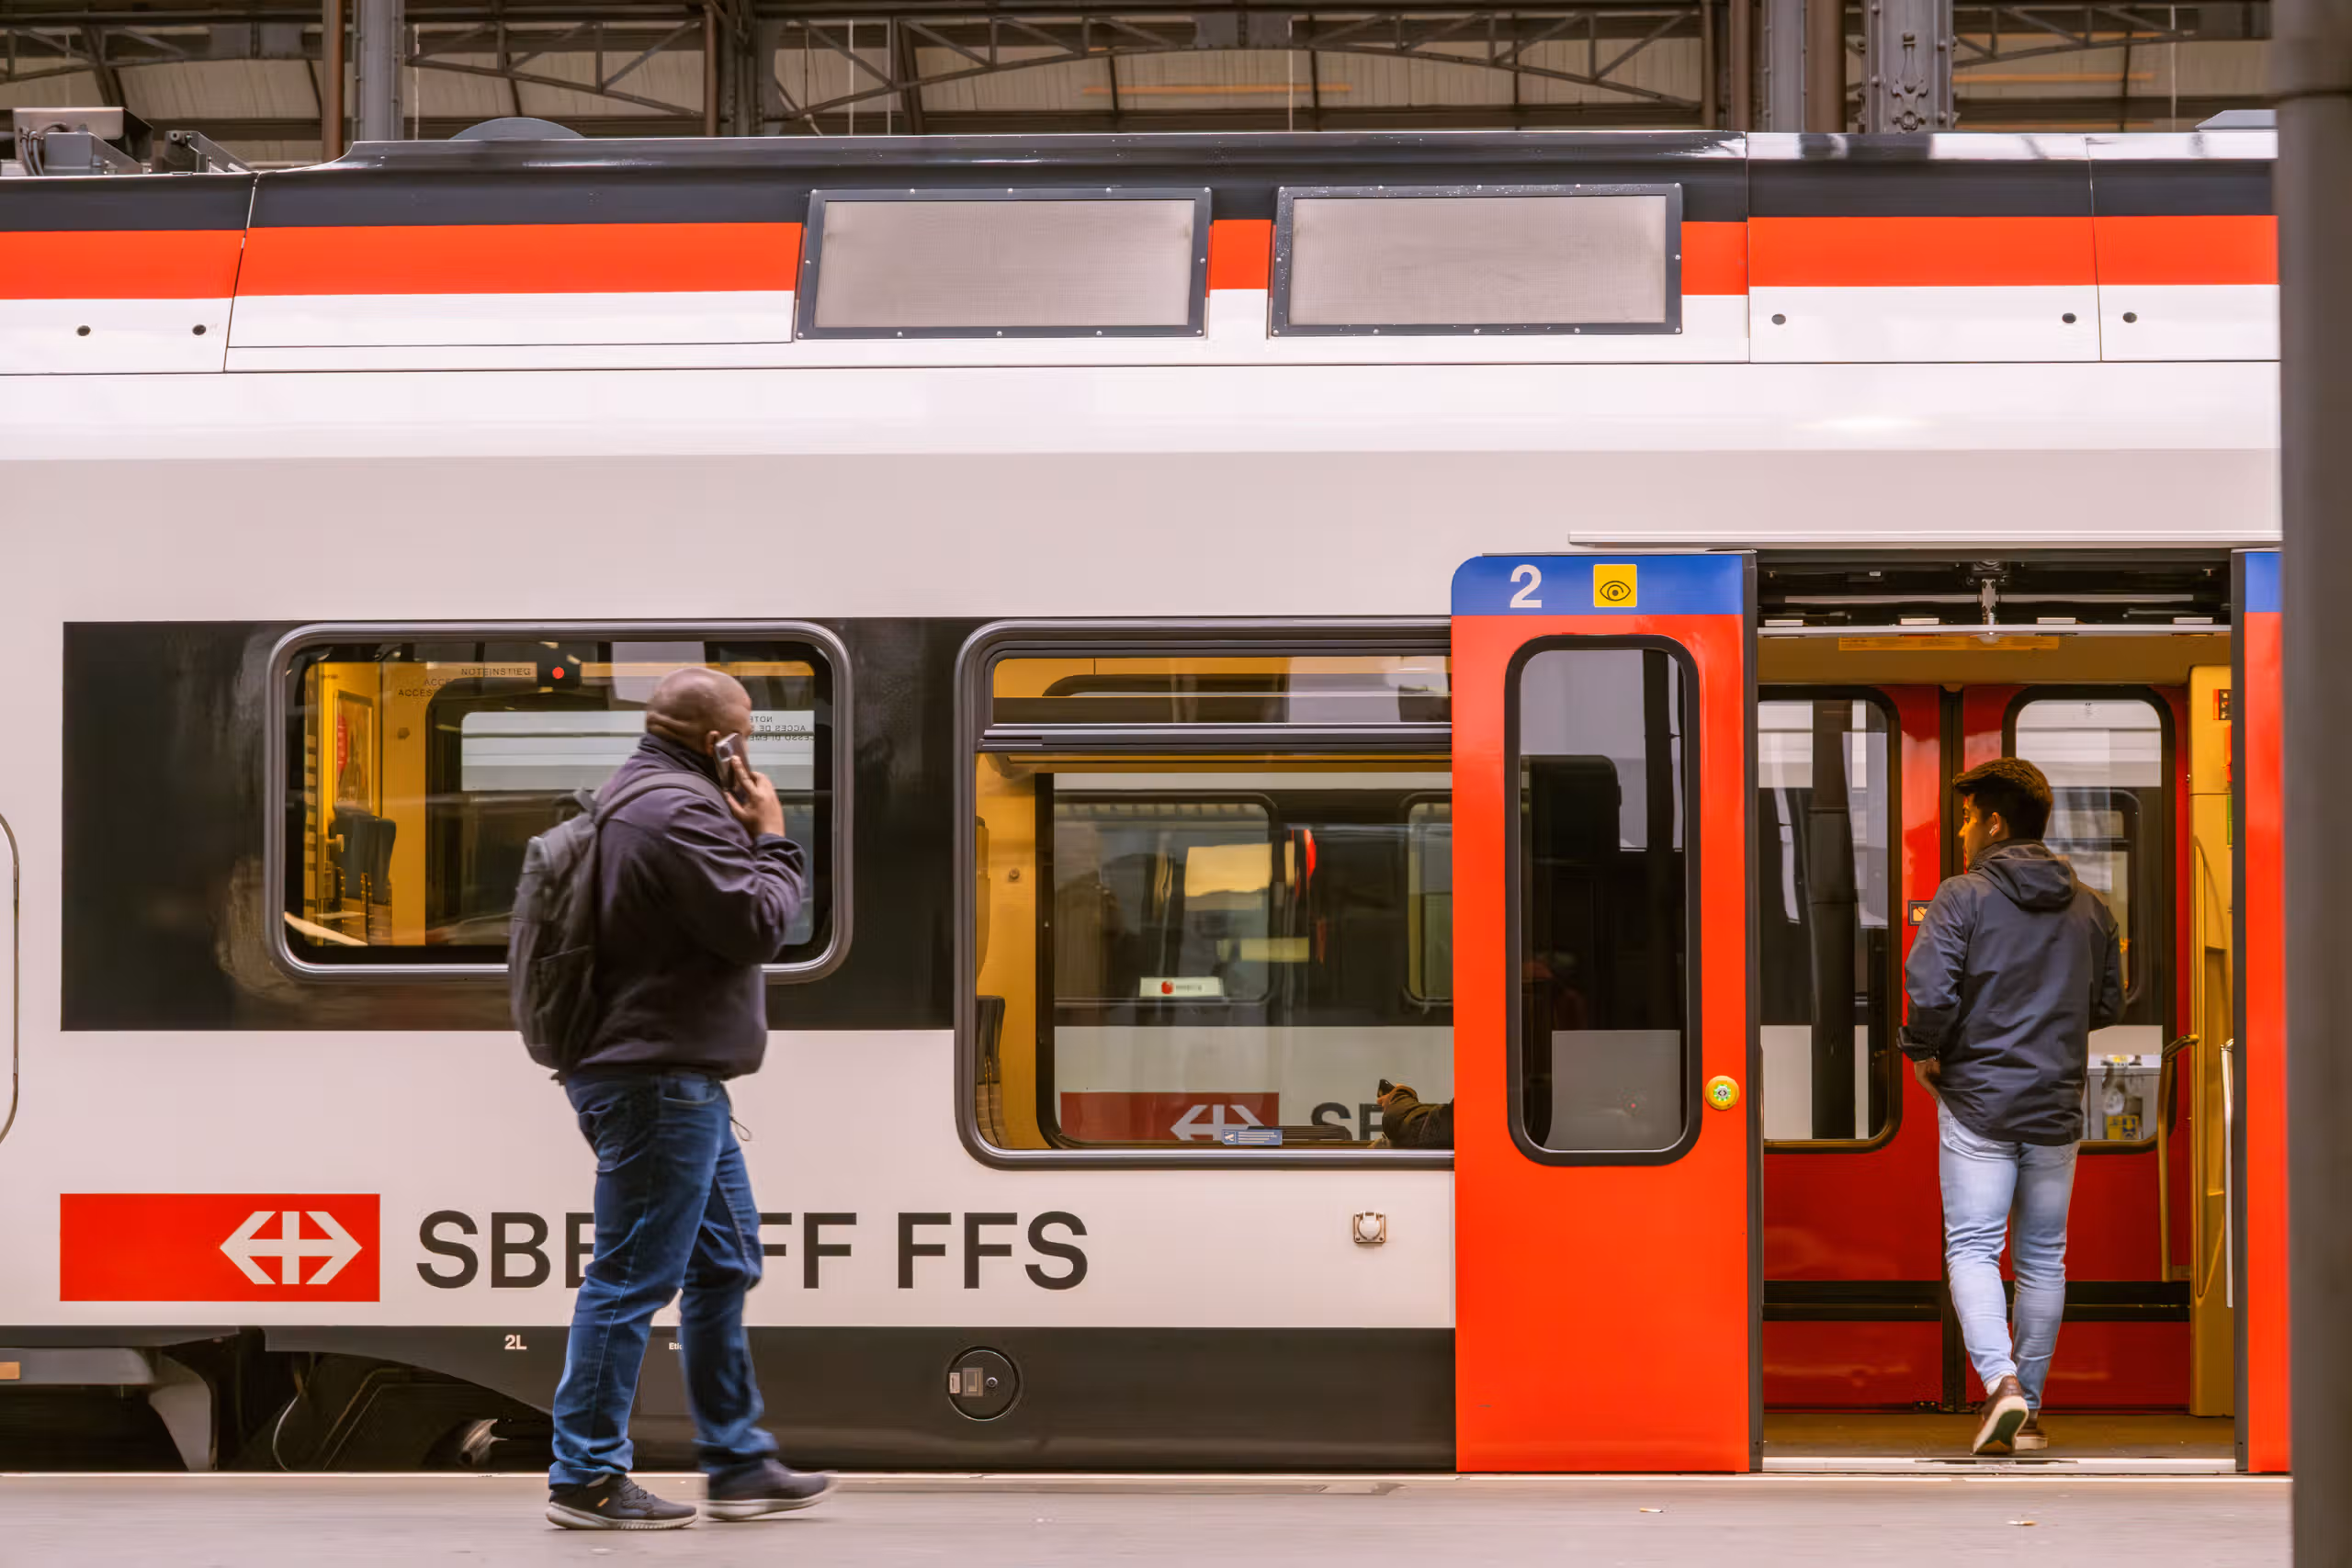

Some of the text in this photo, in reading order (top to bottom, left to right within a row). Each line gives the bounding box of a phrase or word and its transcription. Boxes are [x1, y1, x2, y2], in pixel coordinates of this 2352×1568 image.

[1510, 564, 1543, 608] 2
[460, 668, 531, 677] NOTEINSTIEG
[898, 1210, 1089, 1291] FFS
[504, 1334, 527, 1350] 2L
